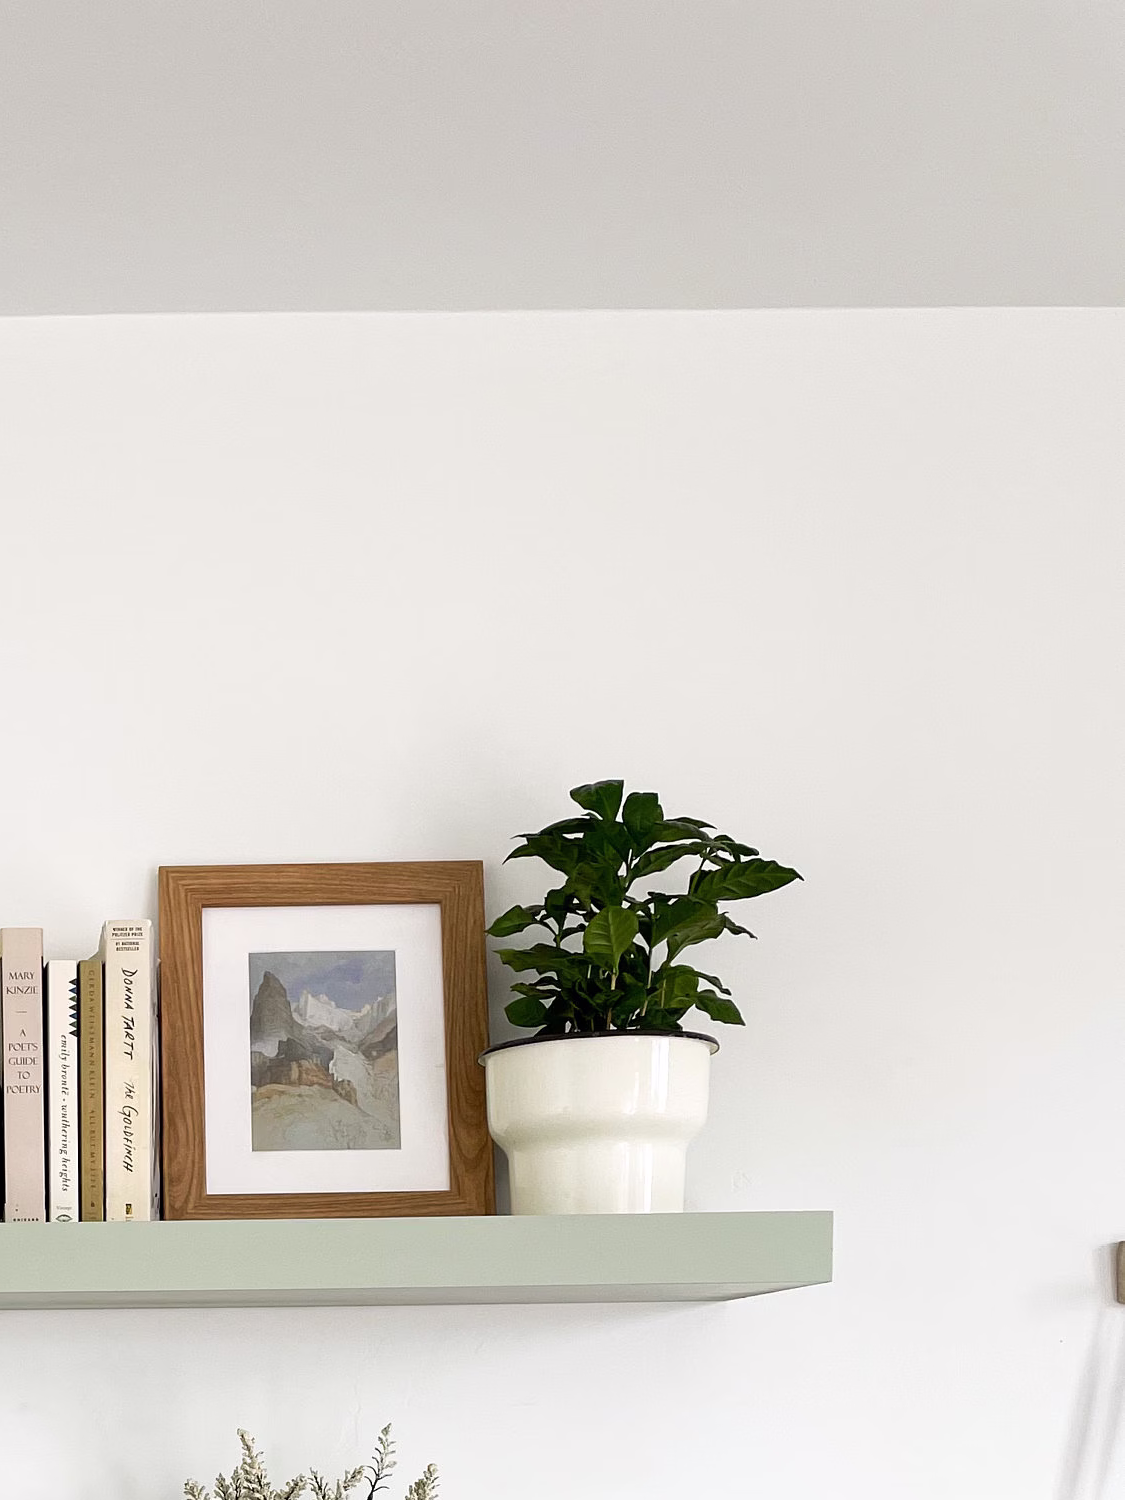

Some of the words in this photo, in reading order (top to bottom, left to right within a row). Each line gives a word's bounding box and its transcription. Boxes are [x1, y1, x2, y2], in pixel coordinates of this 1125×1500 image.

[8, 972, 35, 980] MARY
[6, 986, 38, 995] KINZIE
[121, 967, 138, 1010] DONNA
[19, 1029, 27, 1037] A
[122, 1015, 135, 1061] TARTT
[59, 1034, 70, 1061] emily
[8, 1057, 38, 1066] GUIDE
[17, 1071, 31, 1080] TO
[6, 1085, 41, 1094] POETRY
[124, 1081, 135, 1100] The
[60, 1104, 71, 1155] wuthering
[60, 1157, 72, 1192] heights
